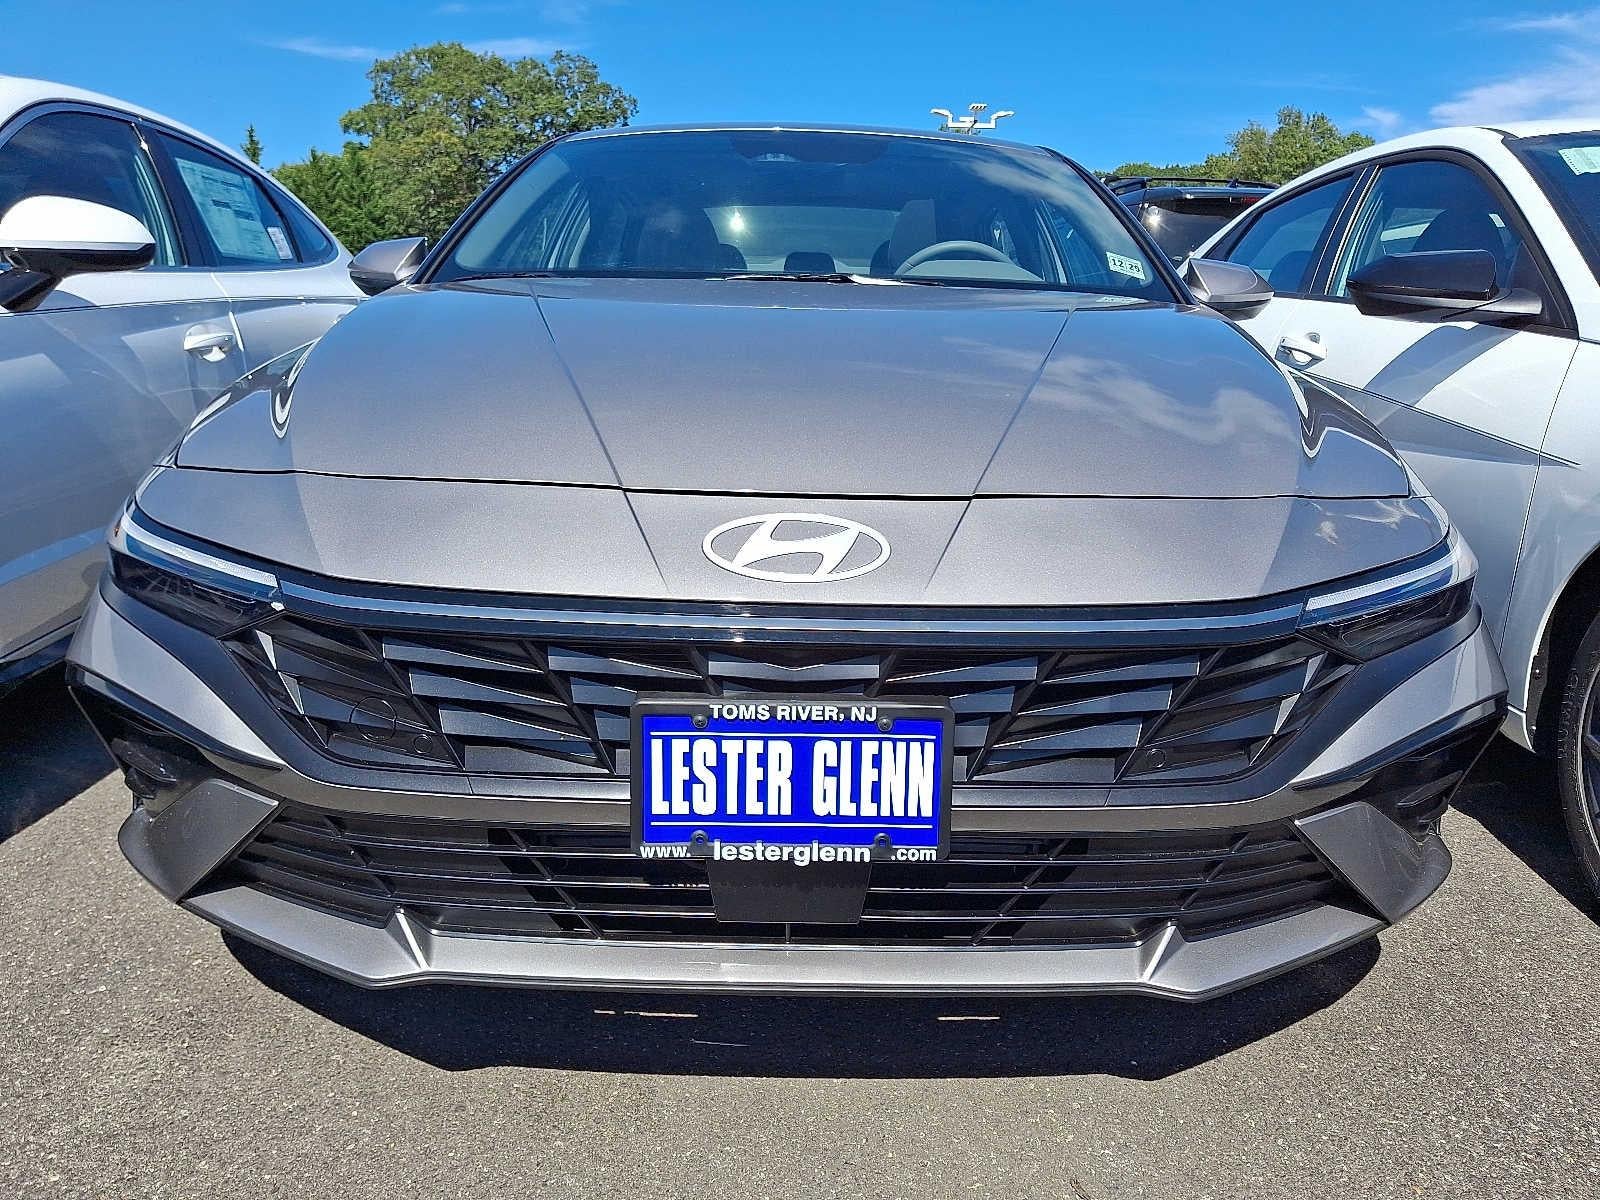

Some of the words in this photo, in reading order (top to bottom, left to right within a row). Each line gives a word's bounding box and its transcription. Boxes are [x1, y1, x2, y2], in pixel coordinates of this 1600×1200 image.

[1111, 258, 1124, 268] 12
[709, 704, 771, 720] TOMS
[776, 705, 845, 722] RIVER,
[850, 706, 877, 722] NJ
[651, 738, 793, 817] LESTER
[812, 739, 935, 818] GLENN
[640, 845, 692, 859] www.
[713, 840, 871, 867] lesterglenn
[890, 846, 937, 861] .com
